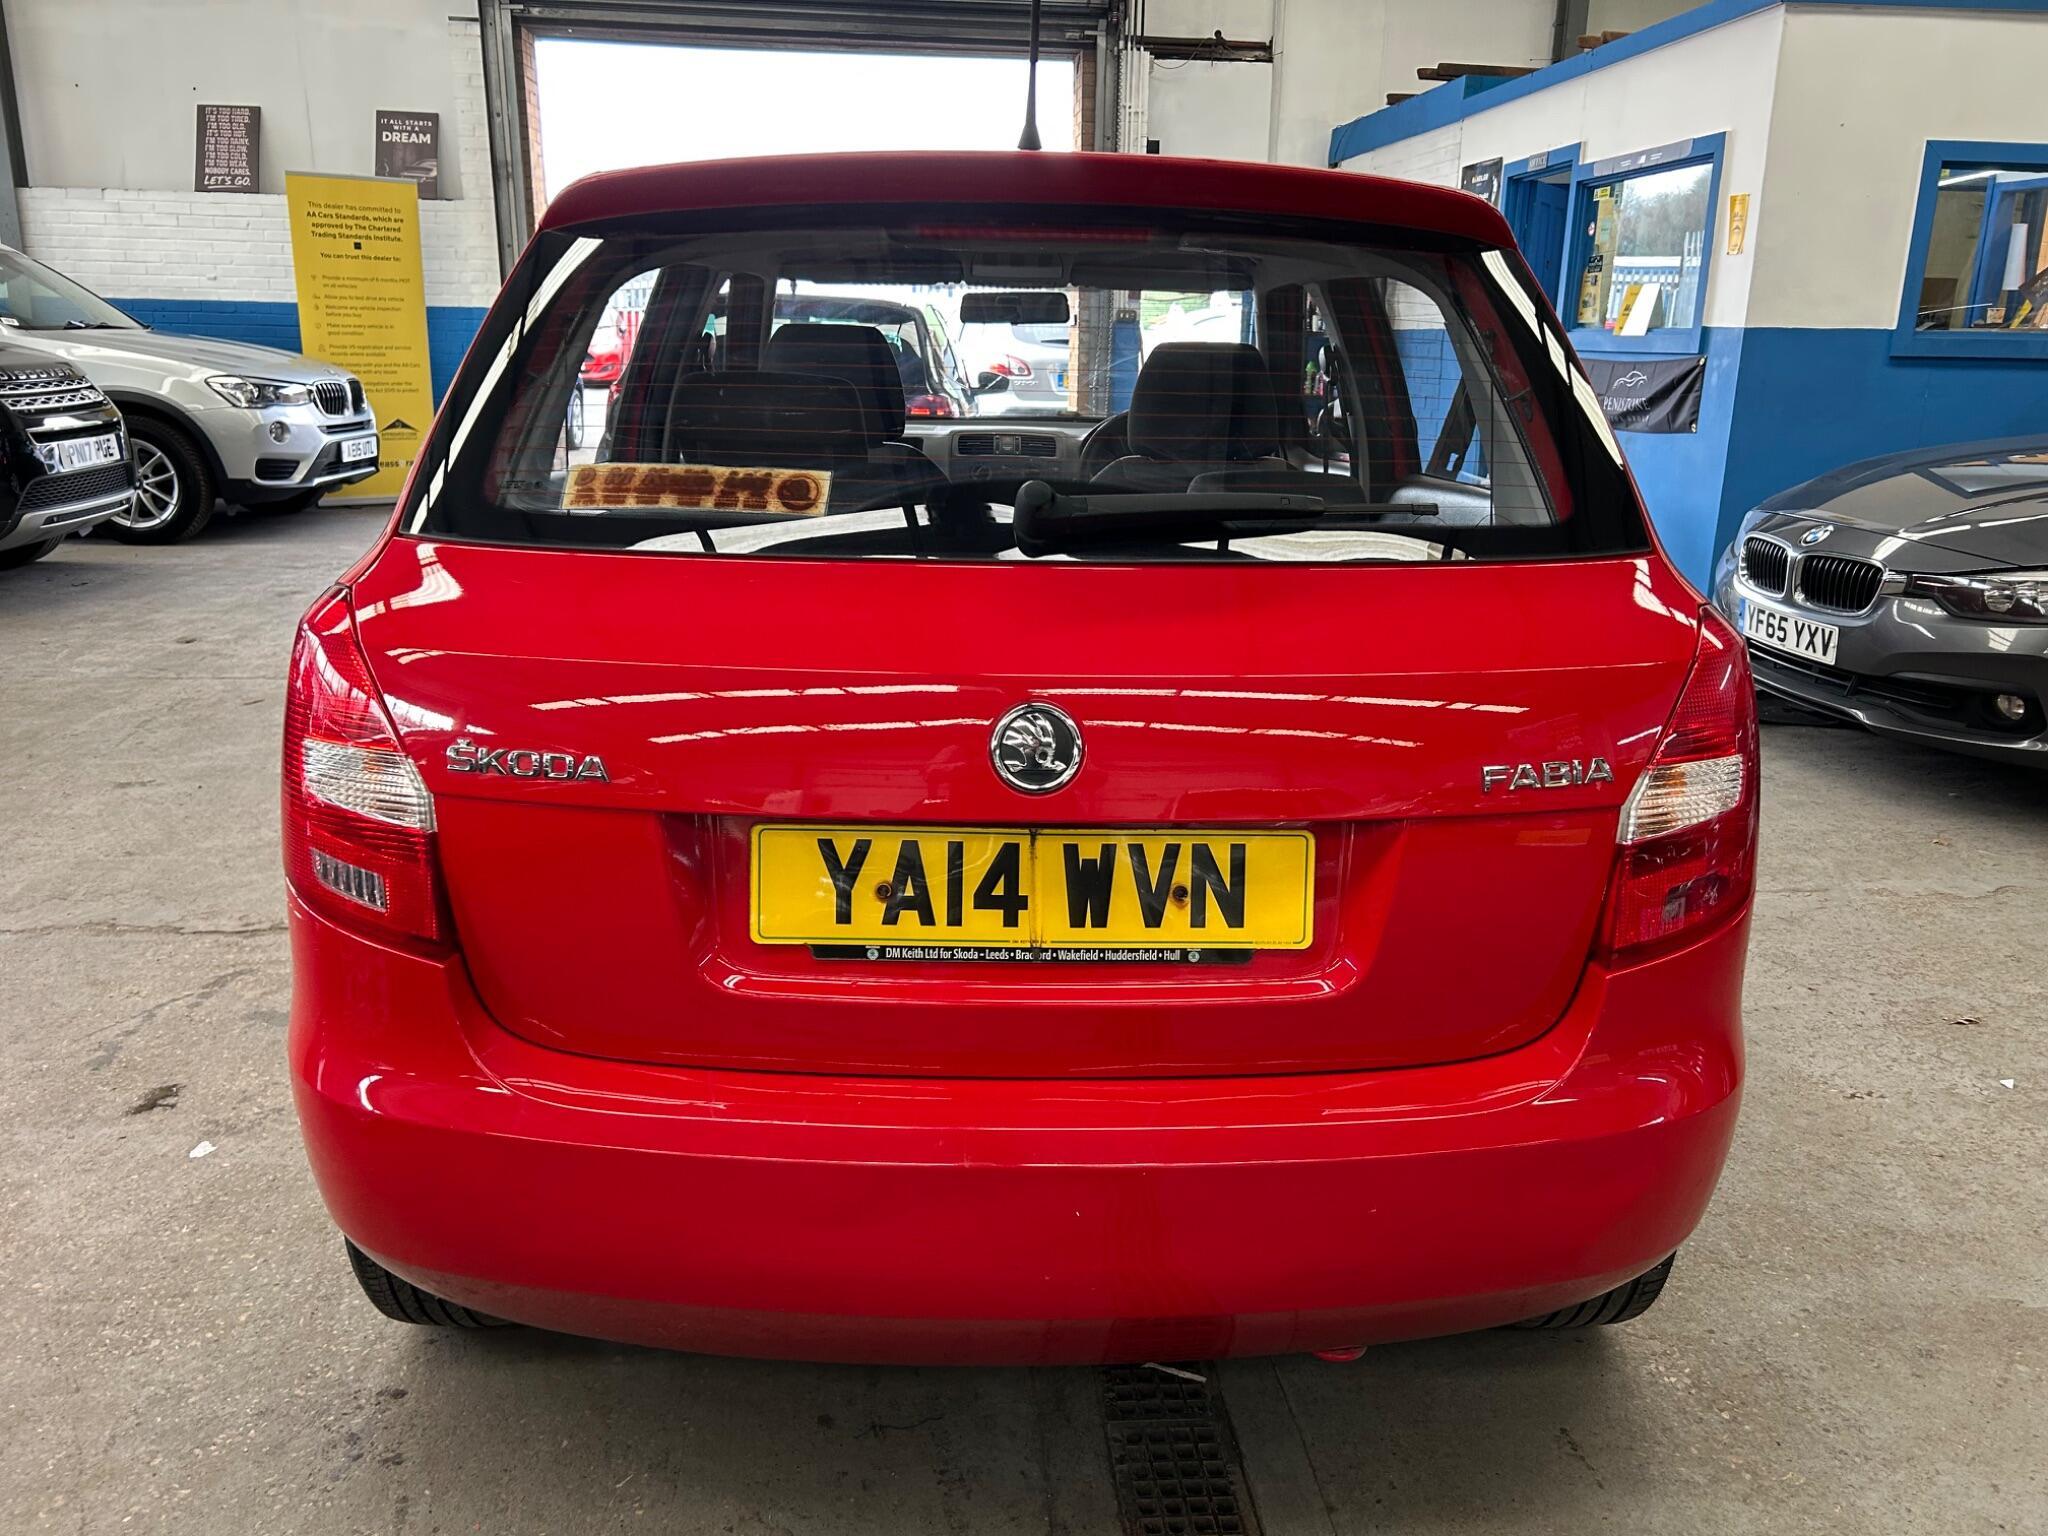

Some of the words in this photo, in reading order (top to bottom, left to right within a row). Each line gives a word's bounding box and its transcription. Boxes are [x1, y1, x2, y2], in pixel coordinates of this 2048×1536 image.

[382, 131, 431, 144] DREAM
[204, 175, 232, 185] LET'S
[234, 177, 251, 186] GO.
[358, 205, 393, 213] committed
[317, 211, 333, 219] Cars
[335, 213, 371, 222] Standards,
[372, 215, 393, 223] which
[345, 223, 353, 231] by
[368, 224, 401, 233] Chartered
[311, 230, 337, 239] Trading
[338, 232, 372, 241] Standards
[1748, 604, 1788, 643] YF65
[1794, 620, 1834, 656] YXV
[445, 736, 611, 783] ŠKODA
[1482, 757, 1615, 792] FABIA
[817, 837, 1029, 928] YA14
[1062, 842, 1246, 930] WVN
[886, 948, 901, 958] DM
[902, 948, 924, 959] Keith
[924, 948, 939, 959] Ltd
[939, 948, 952, 959] for
[953, 948, 978, 959] Skoda
[985, 949, 1010, 960] Leeds
[1015, 949, 1051, 960] Bradord
[1057, 950, 1099, 960] Wakefield
[1104, 950, 1157, 961] Huddersfield
[1163, 950, 1180, 960] Hull
